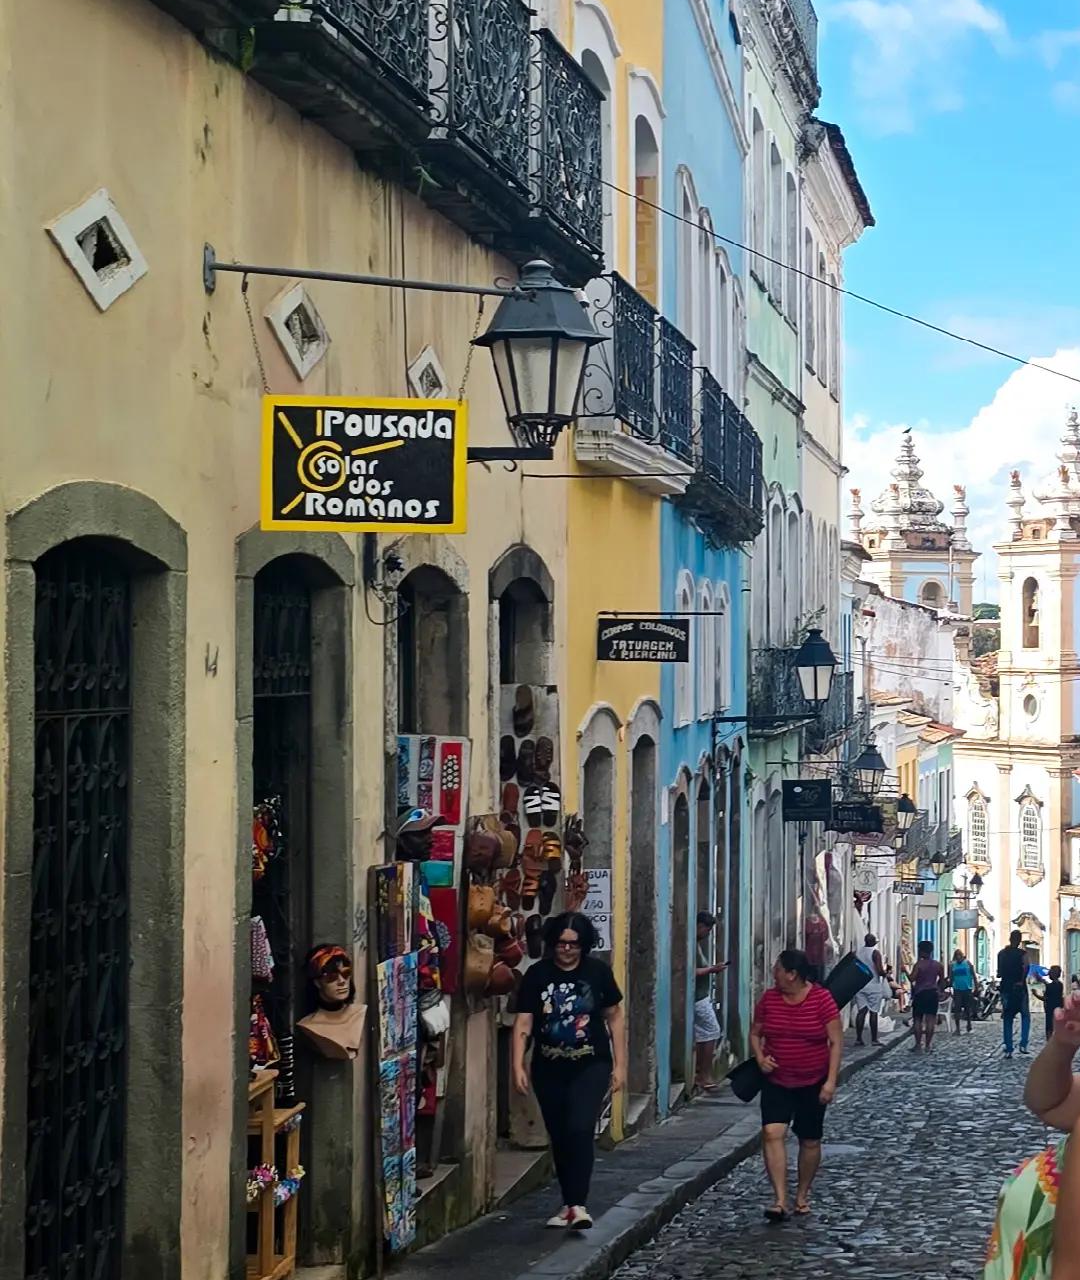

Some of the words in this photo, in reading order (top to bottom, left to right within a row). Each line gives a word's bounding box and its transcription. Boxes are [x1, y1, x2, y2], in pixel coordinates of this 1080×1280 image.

[323, 410, 453, 440] Pousada
[316, 455, 379, 475] solar
[348, 476, 394, 496] dos
[305, 492, 441, 519] Romanos
[588, 870, 609, 880] GUA
